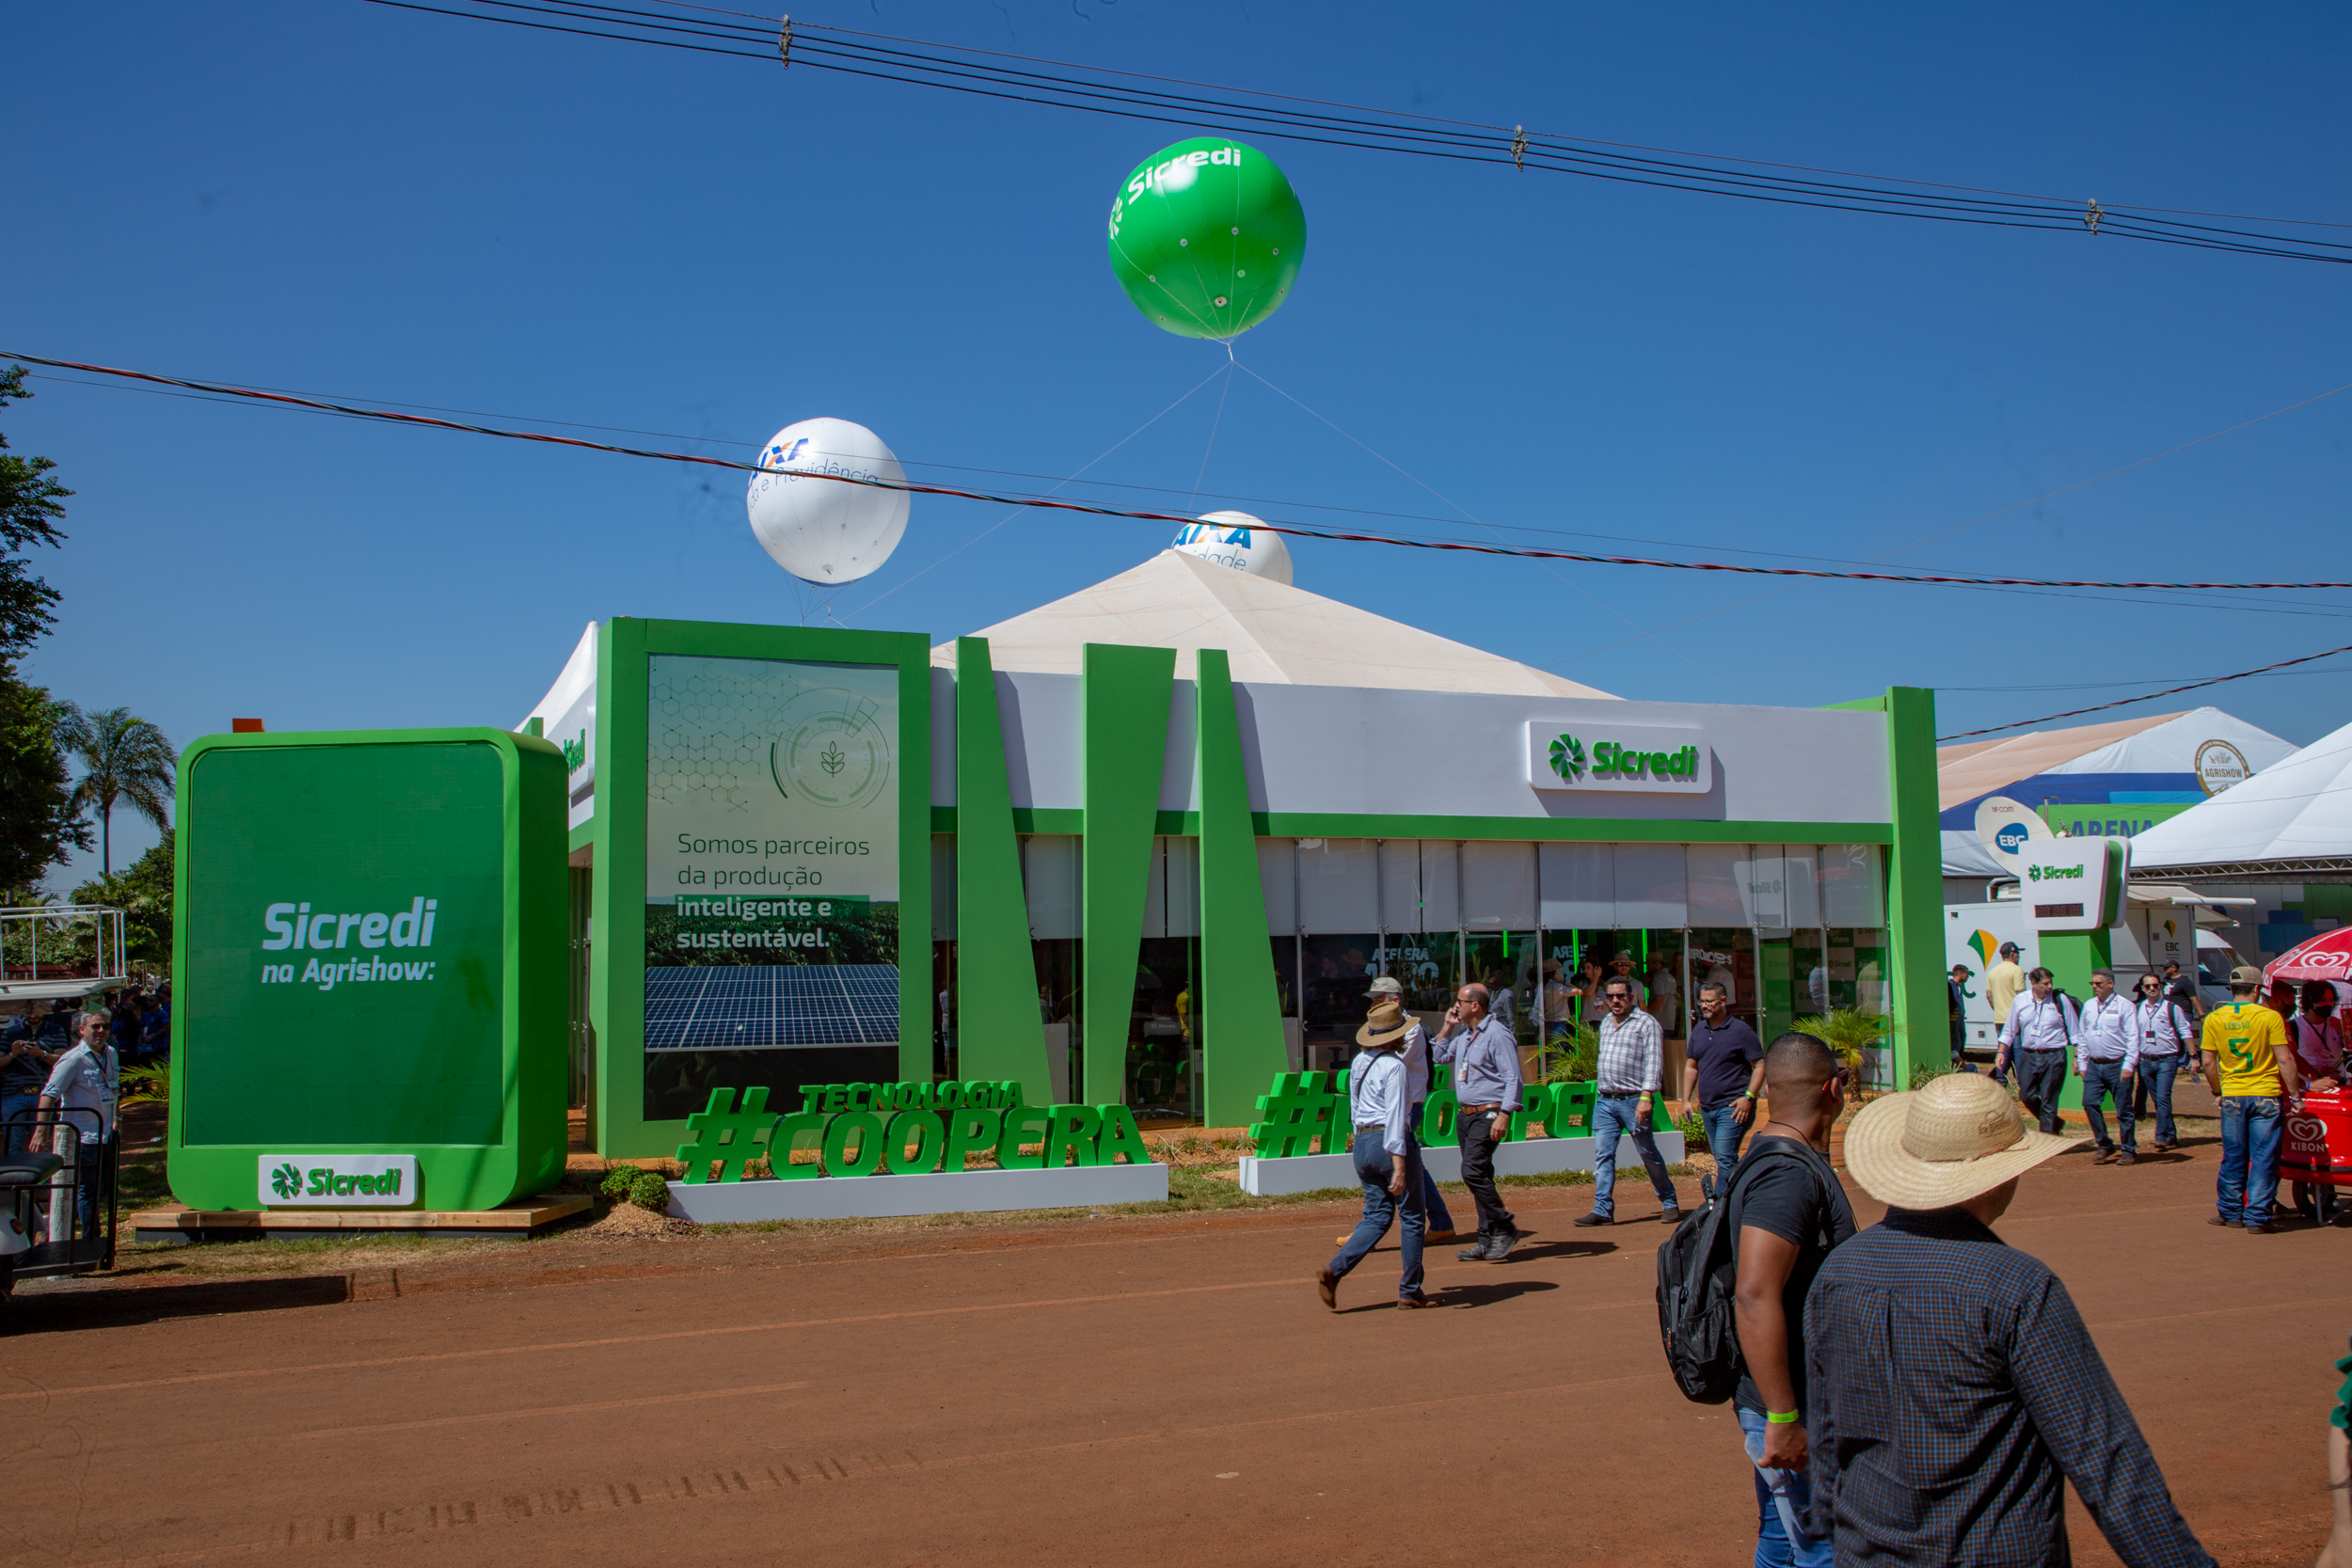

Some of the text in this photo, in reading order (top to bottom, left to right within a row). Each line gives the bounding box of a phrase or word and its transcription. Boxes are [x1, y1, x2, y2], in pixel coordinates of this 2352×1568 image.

[1128, 148, 1241, 205] Sicredi
[1591, 741, 1696, 776] Sicredi
[2204, 768, 2242, 778] AGRISHOW
[677, 833, 869, 858] Somos parceiros
[677, 864, 822, 891] da produção
[2042, 863, 2084, 879] Sicredi
[677, 896, 832, 921] inteligente e
[262, 895, 437, 951] Sicredi
[676, 927, 831, 949] sustentável.
[2165, 942, 2180, 951] EBC
[262, 955, 436, 990] na Agrishow:
[2229, 1037, 2253, 1074] 5
[799, 1080, 1024, 1114] TECNOLOGIA
[675, 1085, 1152, 1185] #COOPERA
[2291, 1141, 2325, 1152] KIBON
[307, 1168, 402, 1196] Sicredi
